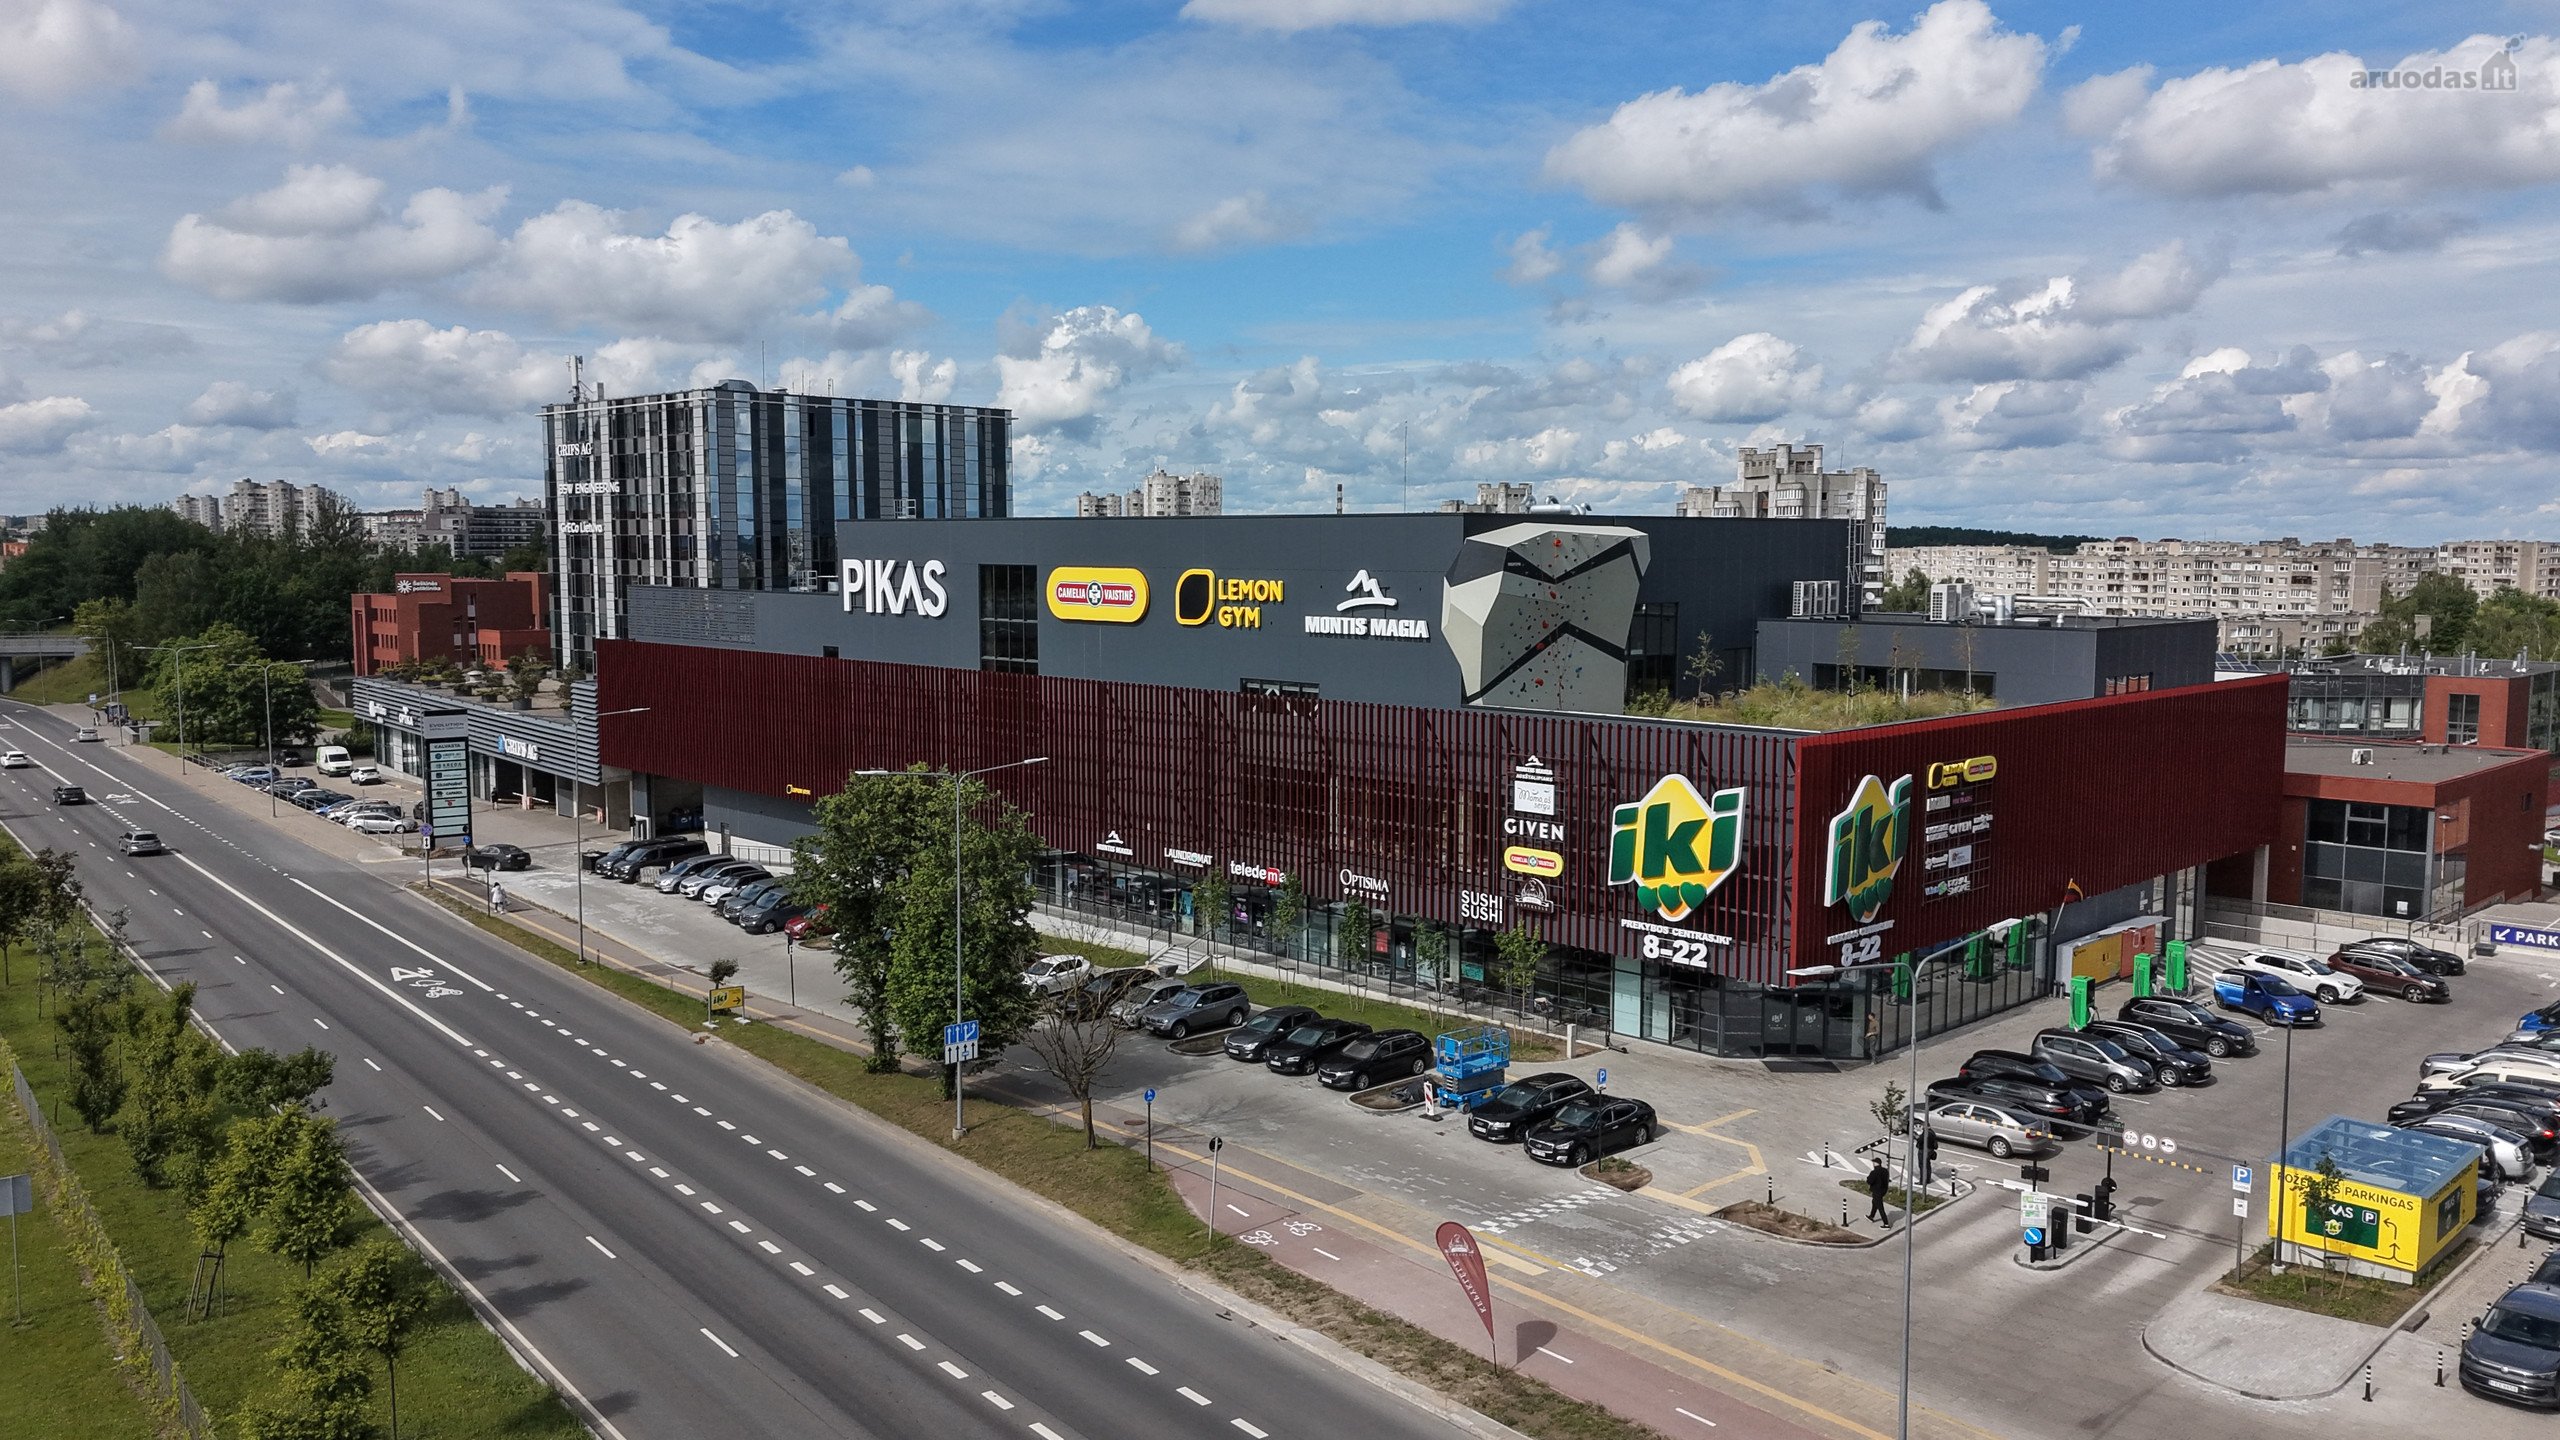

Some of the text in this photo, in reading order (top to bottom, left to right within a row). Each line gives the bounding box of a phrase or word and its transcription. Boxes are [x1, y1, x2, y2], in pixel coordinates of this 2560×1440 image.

[556, 442, 593, 456] GRIFS AG
[575, 482, 620, 494] ENGINEERING
[842, 558, 948, 618] PIKAS
[1057, 586, 1086, 599] CAMELIA
[1218, 578, 1284, 602] LEMON
[1218, 605, 1261, 629] GYM
[1304, 615, 1431, 639] MONTIS MAGIA
[1504, 818, 1564, 841] GIVEN
[1610, 792, 1740, 882] iki
[1832, 776, 1912, 902] iki
[1164, 847, 1213, 866] LAUNDROMAT
[1230, 860, 1287, 884] teledema
[1343, 887, 1387, 902] OPTIKA
[1461, 889, 1503, 910] SUSHI
[1461, 903, 1503, 924] SUSHI
[1620, 918, 1670, 935] PREKYBOS
[2515, 931, 2559, 947] PARK
[2236, 1167, 2248, 1181] P
[2344, 1186, 2414, 1211] PARKINGAS
